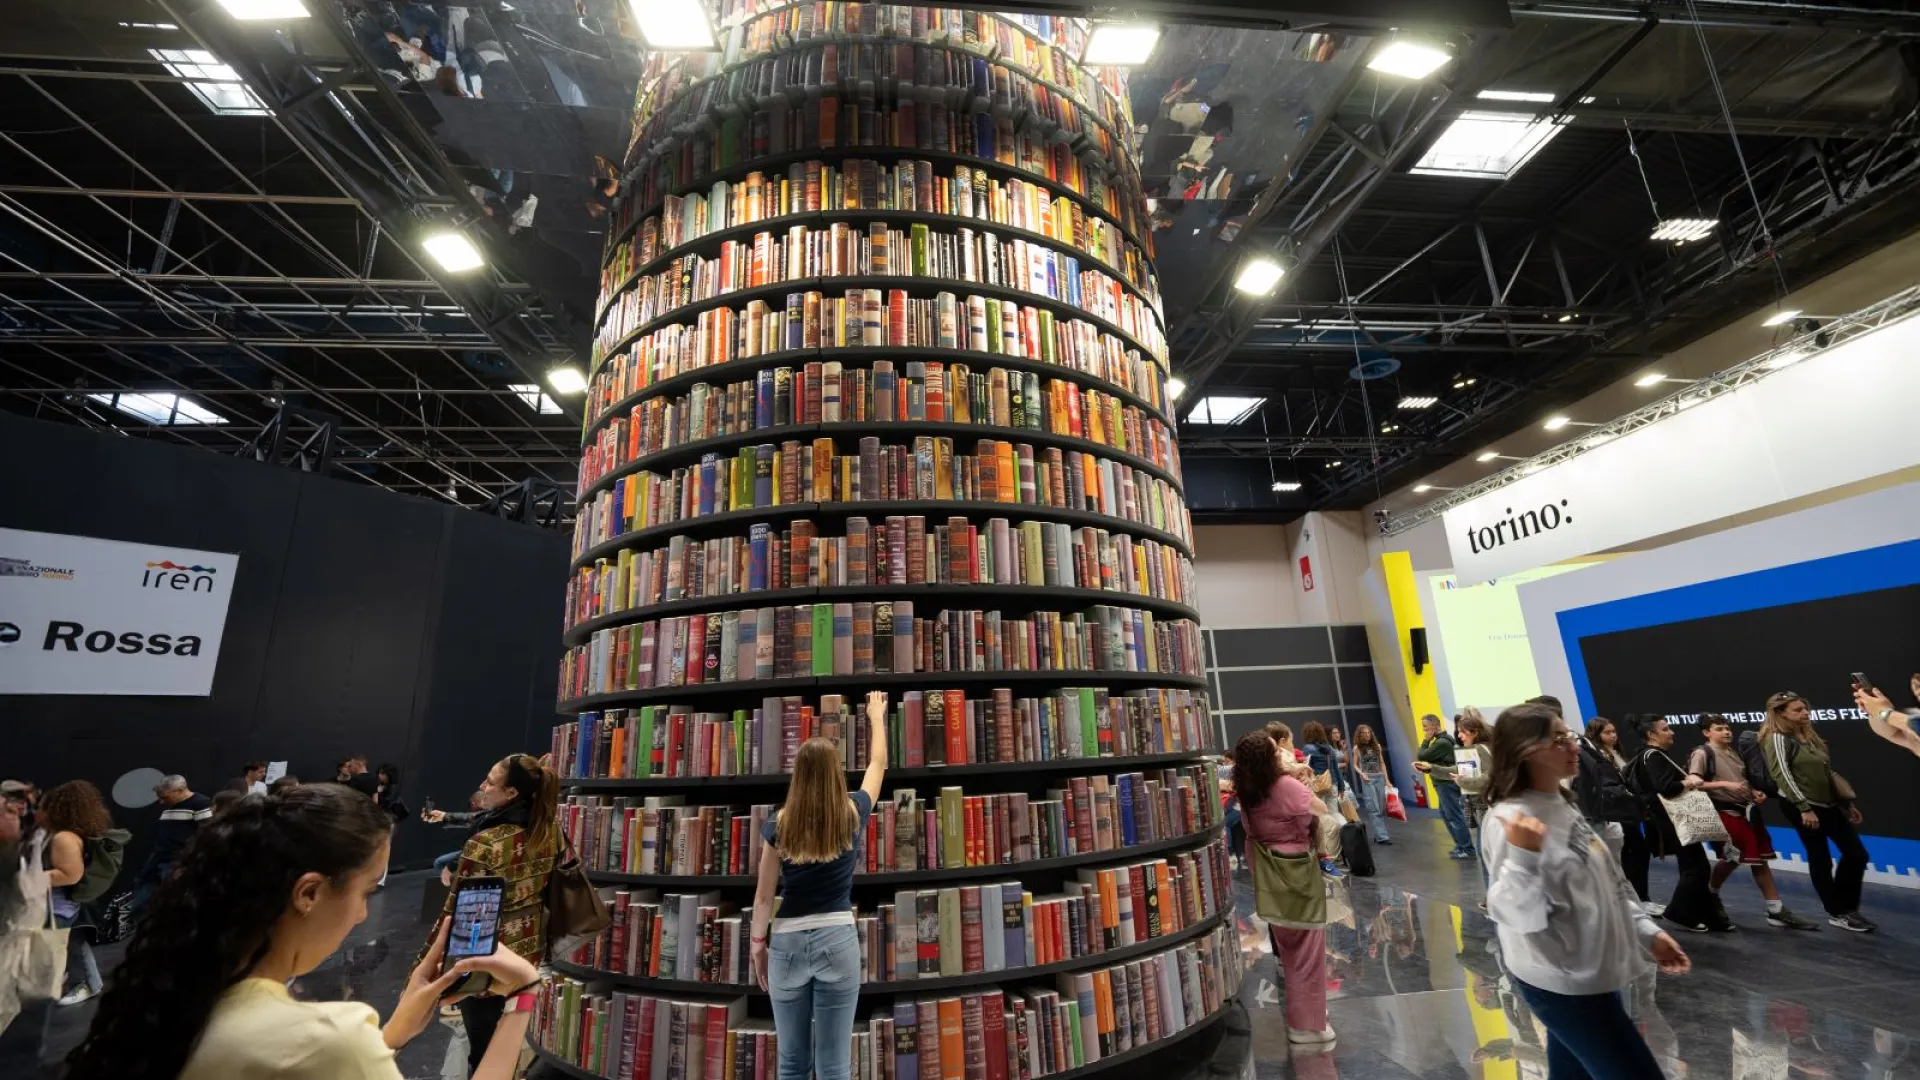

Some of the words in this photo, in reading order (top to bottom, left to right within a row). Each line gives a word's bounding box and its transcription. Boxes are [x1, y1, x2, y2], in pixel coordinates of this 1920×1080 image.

[1467, 499, 1572, 554] torino:
[42, 620, 202, 657] Rossa
[1664, 714, 1680, 725] IN
[1721, 711, 1748, 724] THE
[1838, 708, 1869, 720] FIR
